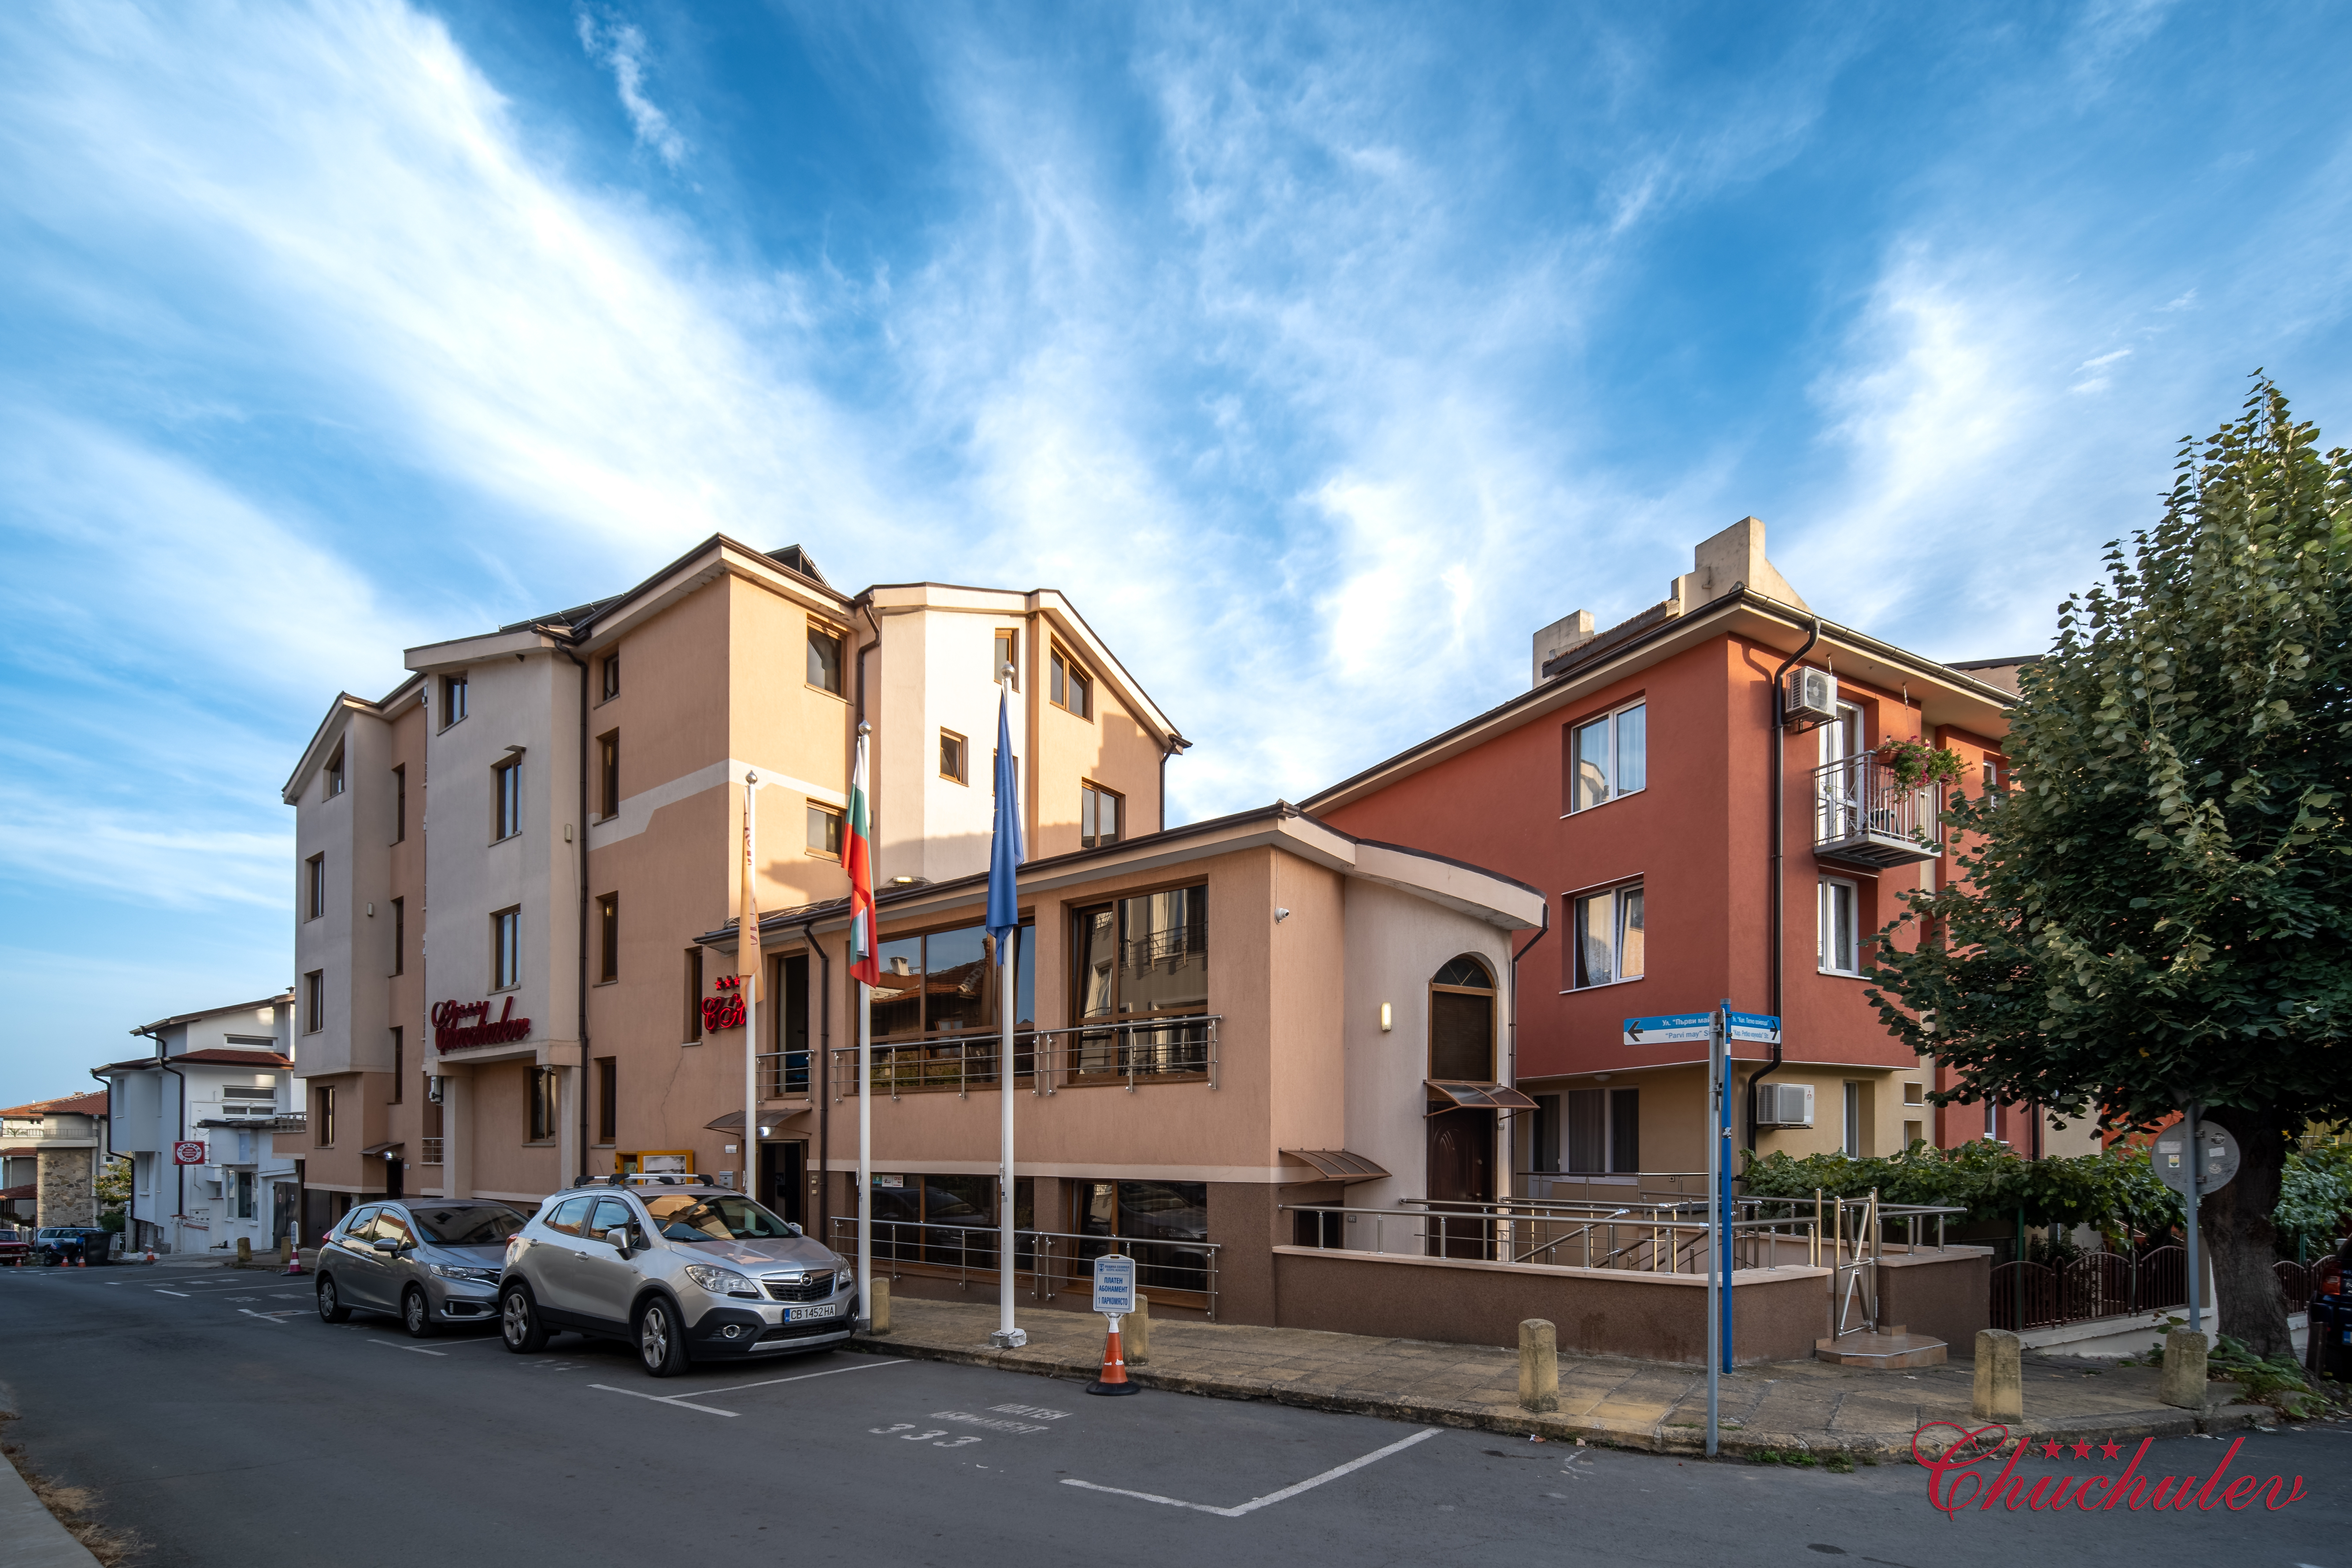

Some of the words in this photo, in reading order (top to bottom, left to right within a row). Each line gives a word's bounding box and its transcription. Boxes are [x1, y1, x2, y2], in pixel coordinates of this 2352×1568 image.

[178, 1144, 200, 1153] CORNER
[1101, 1297, 1128, 1305] ПАРКОМЯСТО
[791, 1309, 802, 1320] CB
[805, 1307, 823, 1318] 1452
[825, 1306, 834, 1316] HA
[868, 1423, 982, 1447] 333
